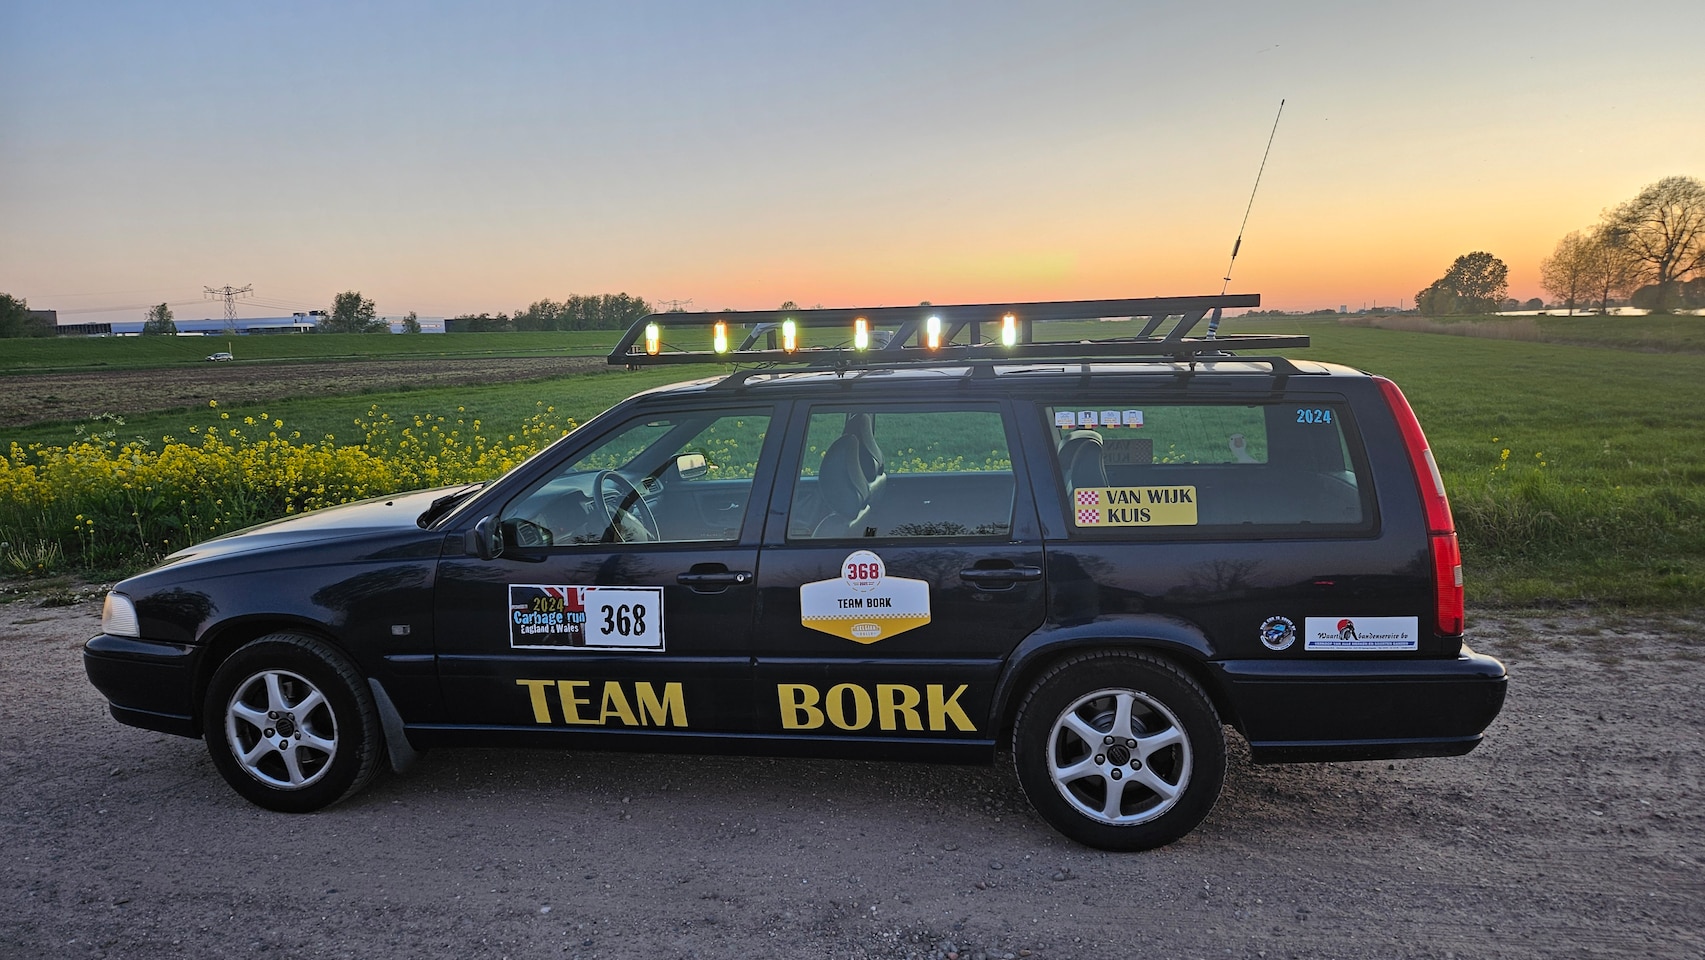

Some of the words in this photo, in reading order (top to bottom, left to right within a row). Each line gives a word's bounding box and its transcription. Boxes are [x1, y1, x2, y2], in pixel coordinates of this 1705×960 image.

[1296, 408, 1332, 424] 2024
[1106, 490, 1141, 504] VAN
[1147, 488, 1193, 504] WIJK
[1107, 508, 1151, 523] KUIS
[847, 563, 879, 580] 368
[533, 597, 565, 612] 2024
[837, 598, 863, 608] TEAM
[866, 597, 892, 608] BORK
[513, 611, 563, 625] Carbage
[566, 611, 586, 623] run
[600, 604, 646, 637] 368
[521, 624, 549, 635] England
[551, 625, 555, 633] &
[556, 623, 579, 633] Wales
[516, 679, 689, 727] TEAM
[777, 683, 977, 731] BORK
